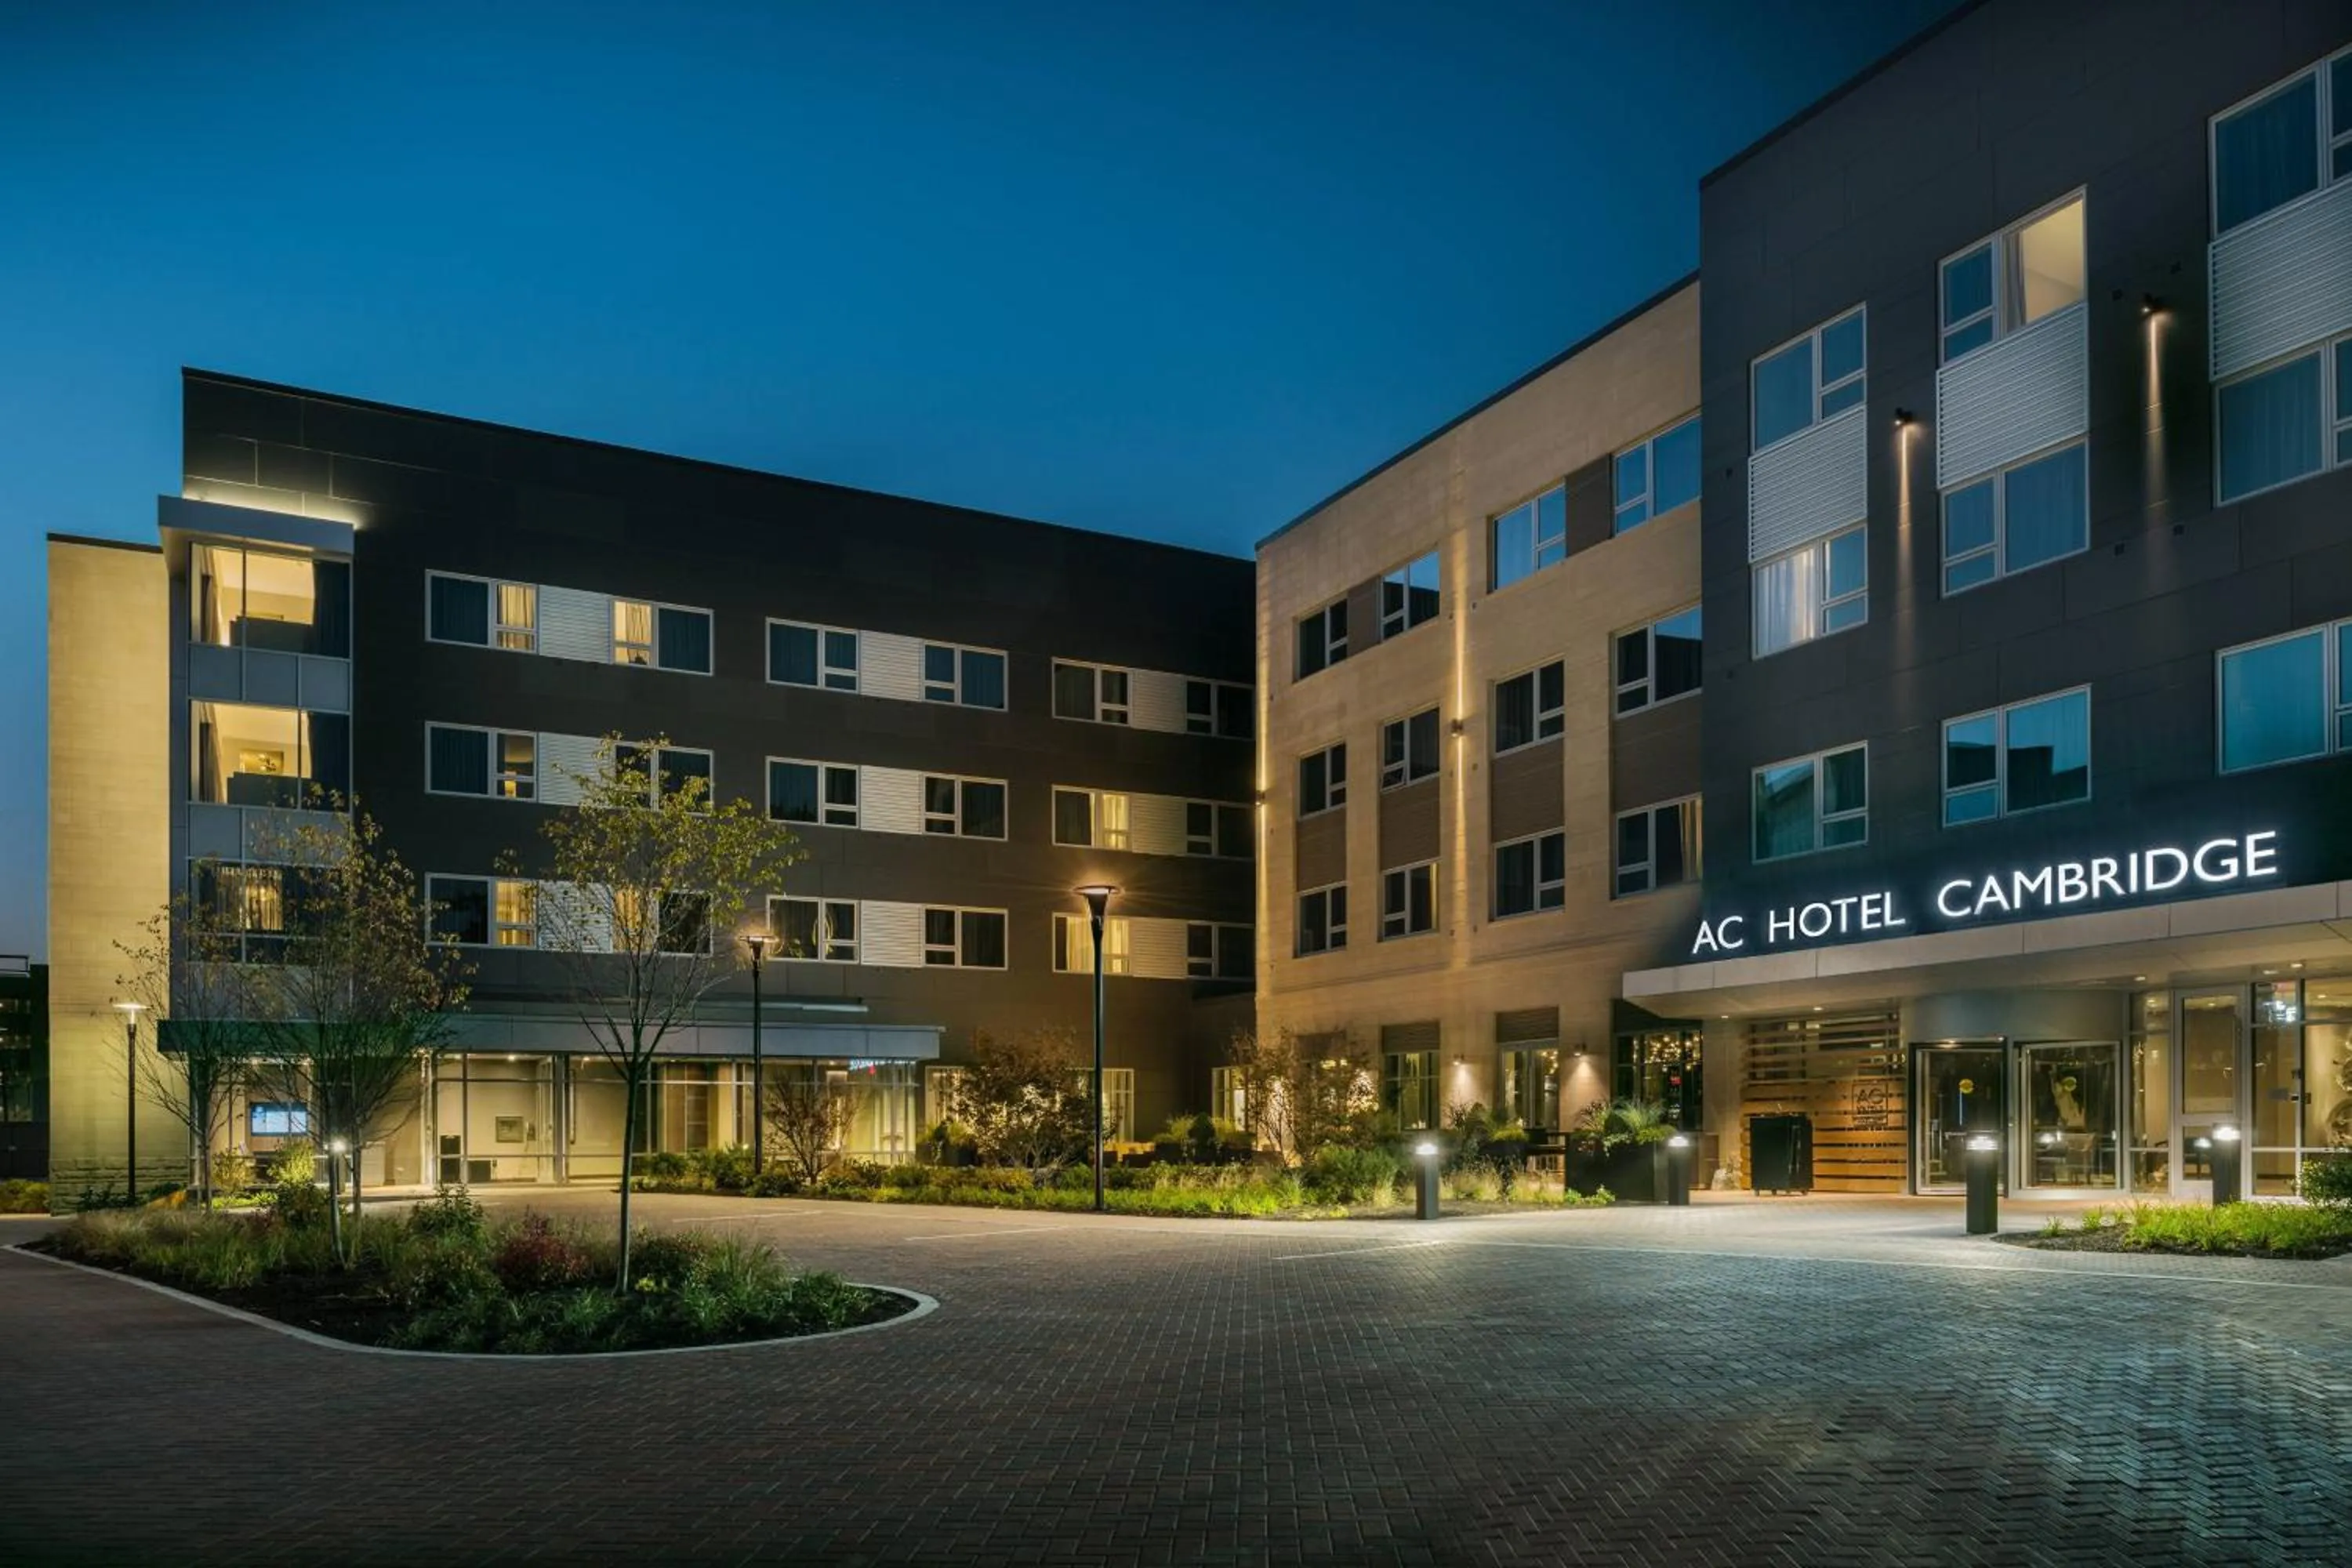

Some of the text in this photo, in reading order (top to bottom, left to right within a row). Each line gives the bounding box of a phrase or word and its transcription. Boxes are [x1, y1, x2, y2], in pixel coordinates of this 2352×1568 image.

[1693, 830, 2277, 954] AC HOTEL CAMBRIDGE
